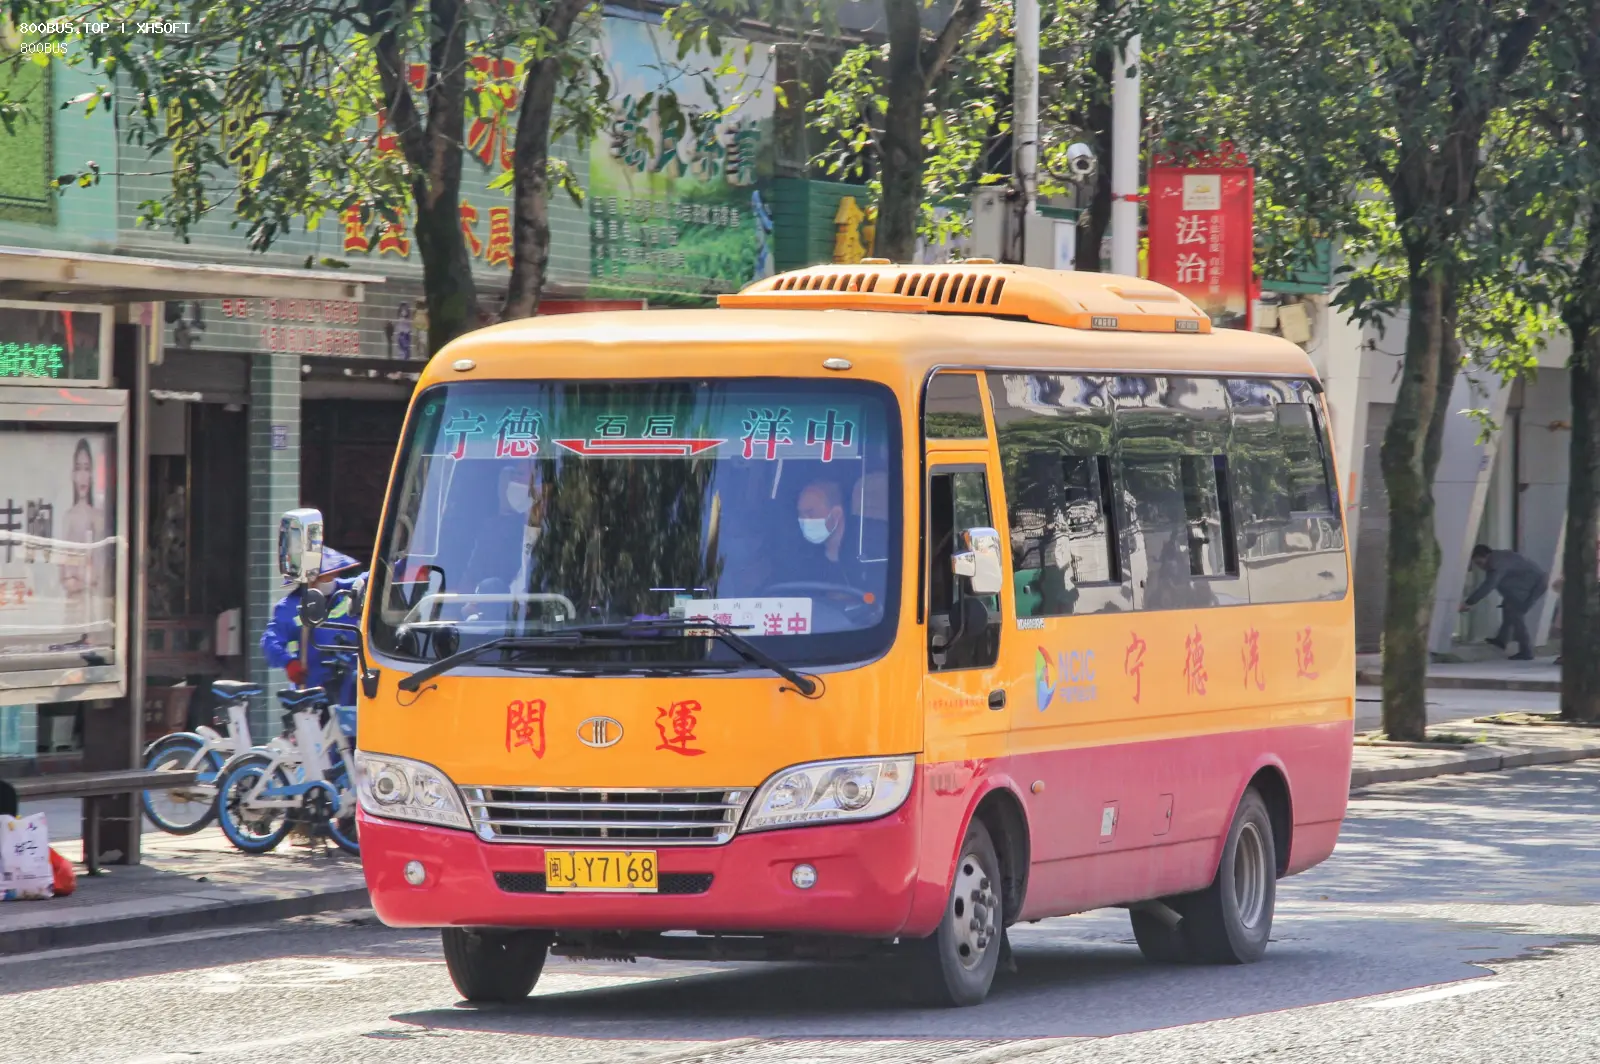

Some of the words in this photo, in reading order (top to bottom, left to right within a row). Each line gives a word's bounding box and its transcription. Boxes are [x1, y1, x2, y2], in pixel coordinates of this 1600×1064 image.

[1175, 214, 1208, 283] 法治
[444, 407, 543, 460] 宁德
[595, 415, 676, 438] 石后
[741, 407, 857, 463] 洋中
[763, 612, 807, 636] 洋中
[1058, 649, 1095, 683] NCIC
[655, 699, 707, 757] 運
